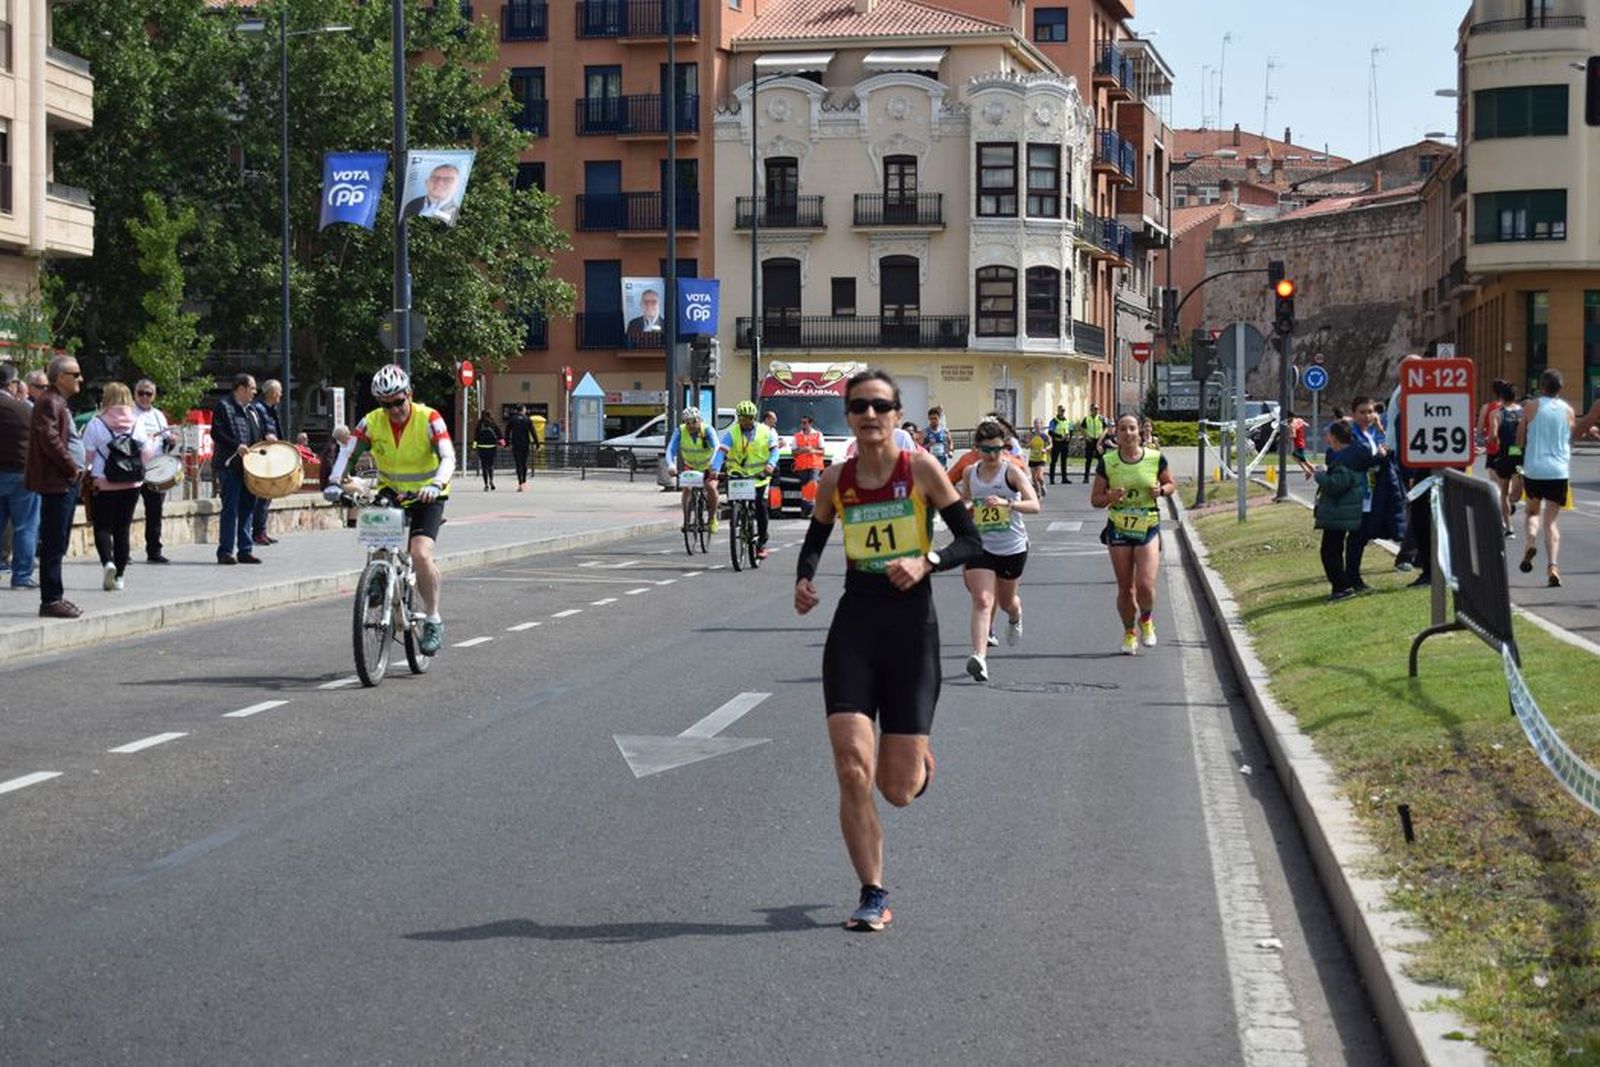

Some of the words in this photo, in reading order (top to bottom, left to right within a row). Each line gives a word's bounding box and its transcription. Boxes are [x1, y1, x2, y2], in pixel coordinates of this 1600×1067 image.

[332, 170, 370, 181] VOTA
[686, 293, 711, 302] VOTA
[1408, 367, 1468, 388] N-122
[1424, 402, 1452, 417] km
[1410, 426, 1467, 454] 459
[981, 507, 1000, 522] 23
[1123, 516, 1138, 529] 17
[865, 523, 896, 552] 41
